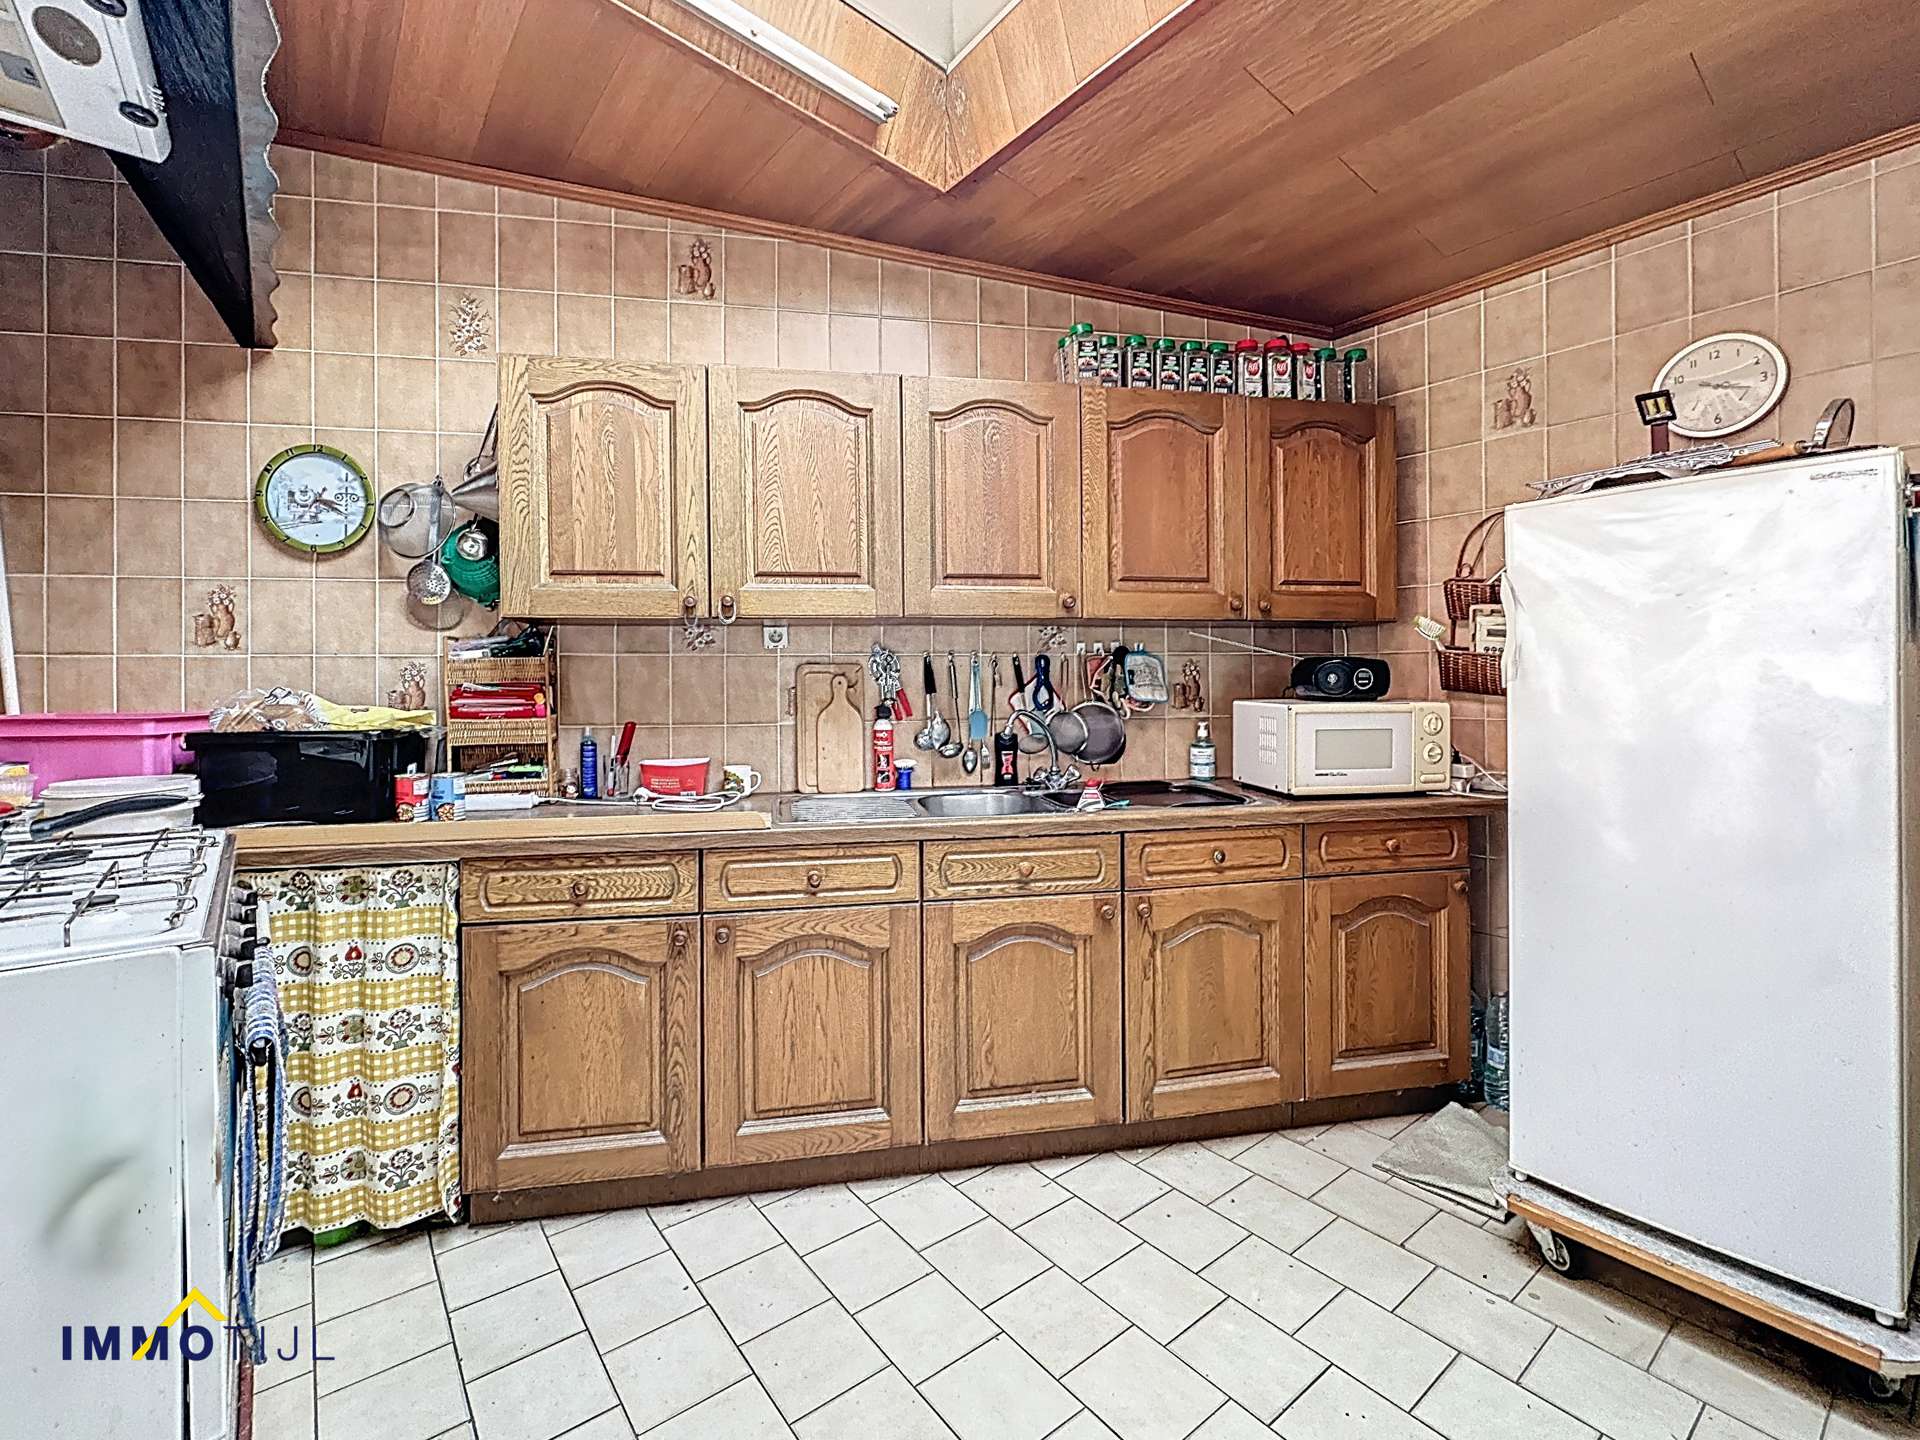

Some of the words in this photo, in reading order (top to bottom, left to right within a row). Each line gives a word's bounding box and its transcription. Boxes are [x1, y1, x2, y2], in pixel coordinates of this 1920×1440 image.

[1709, 350, 1721, 360] 12
[1690, 359, 1697, 368] 11
[1753, 356, 1761, 365] 2
[1674, 375, 1684, 385] 10
[1760, 371, 1768, 382] 3
[1714, 413, 1722, 424] 6
[313, 445, 323, 453] 12
[263, 464, 273, 474] 10
